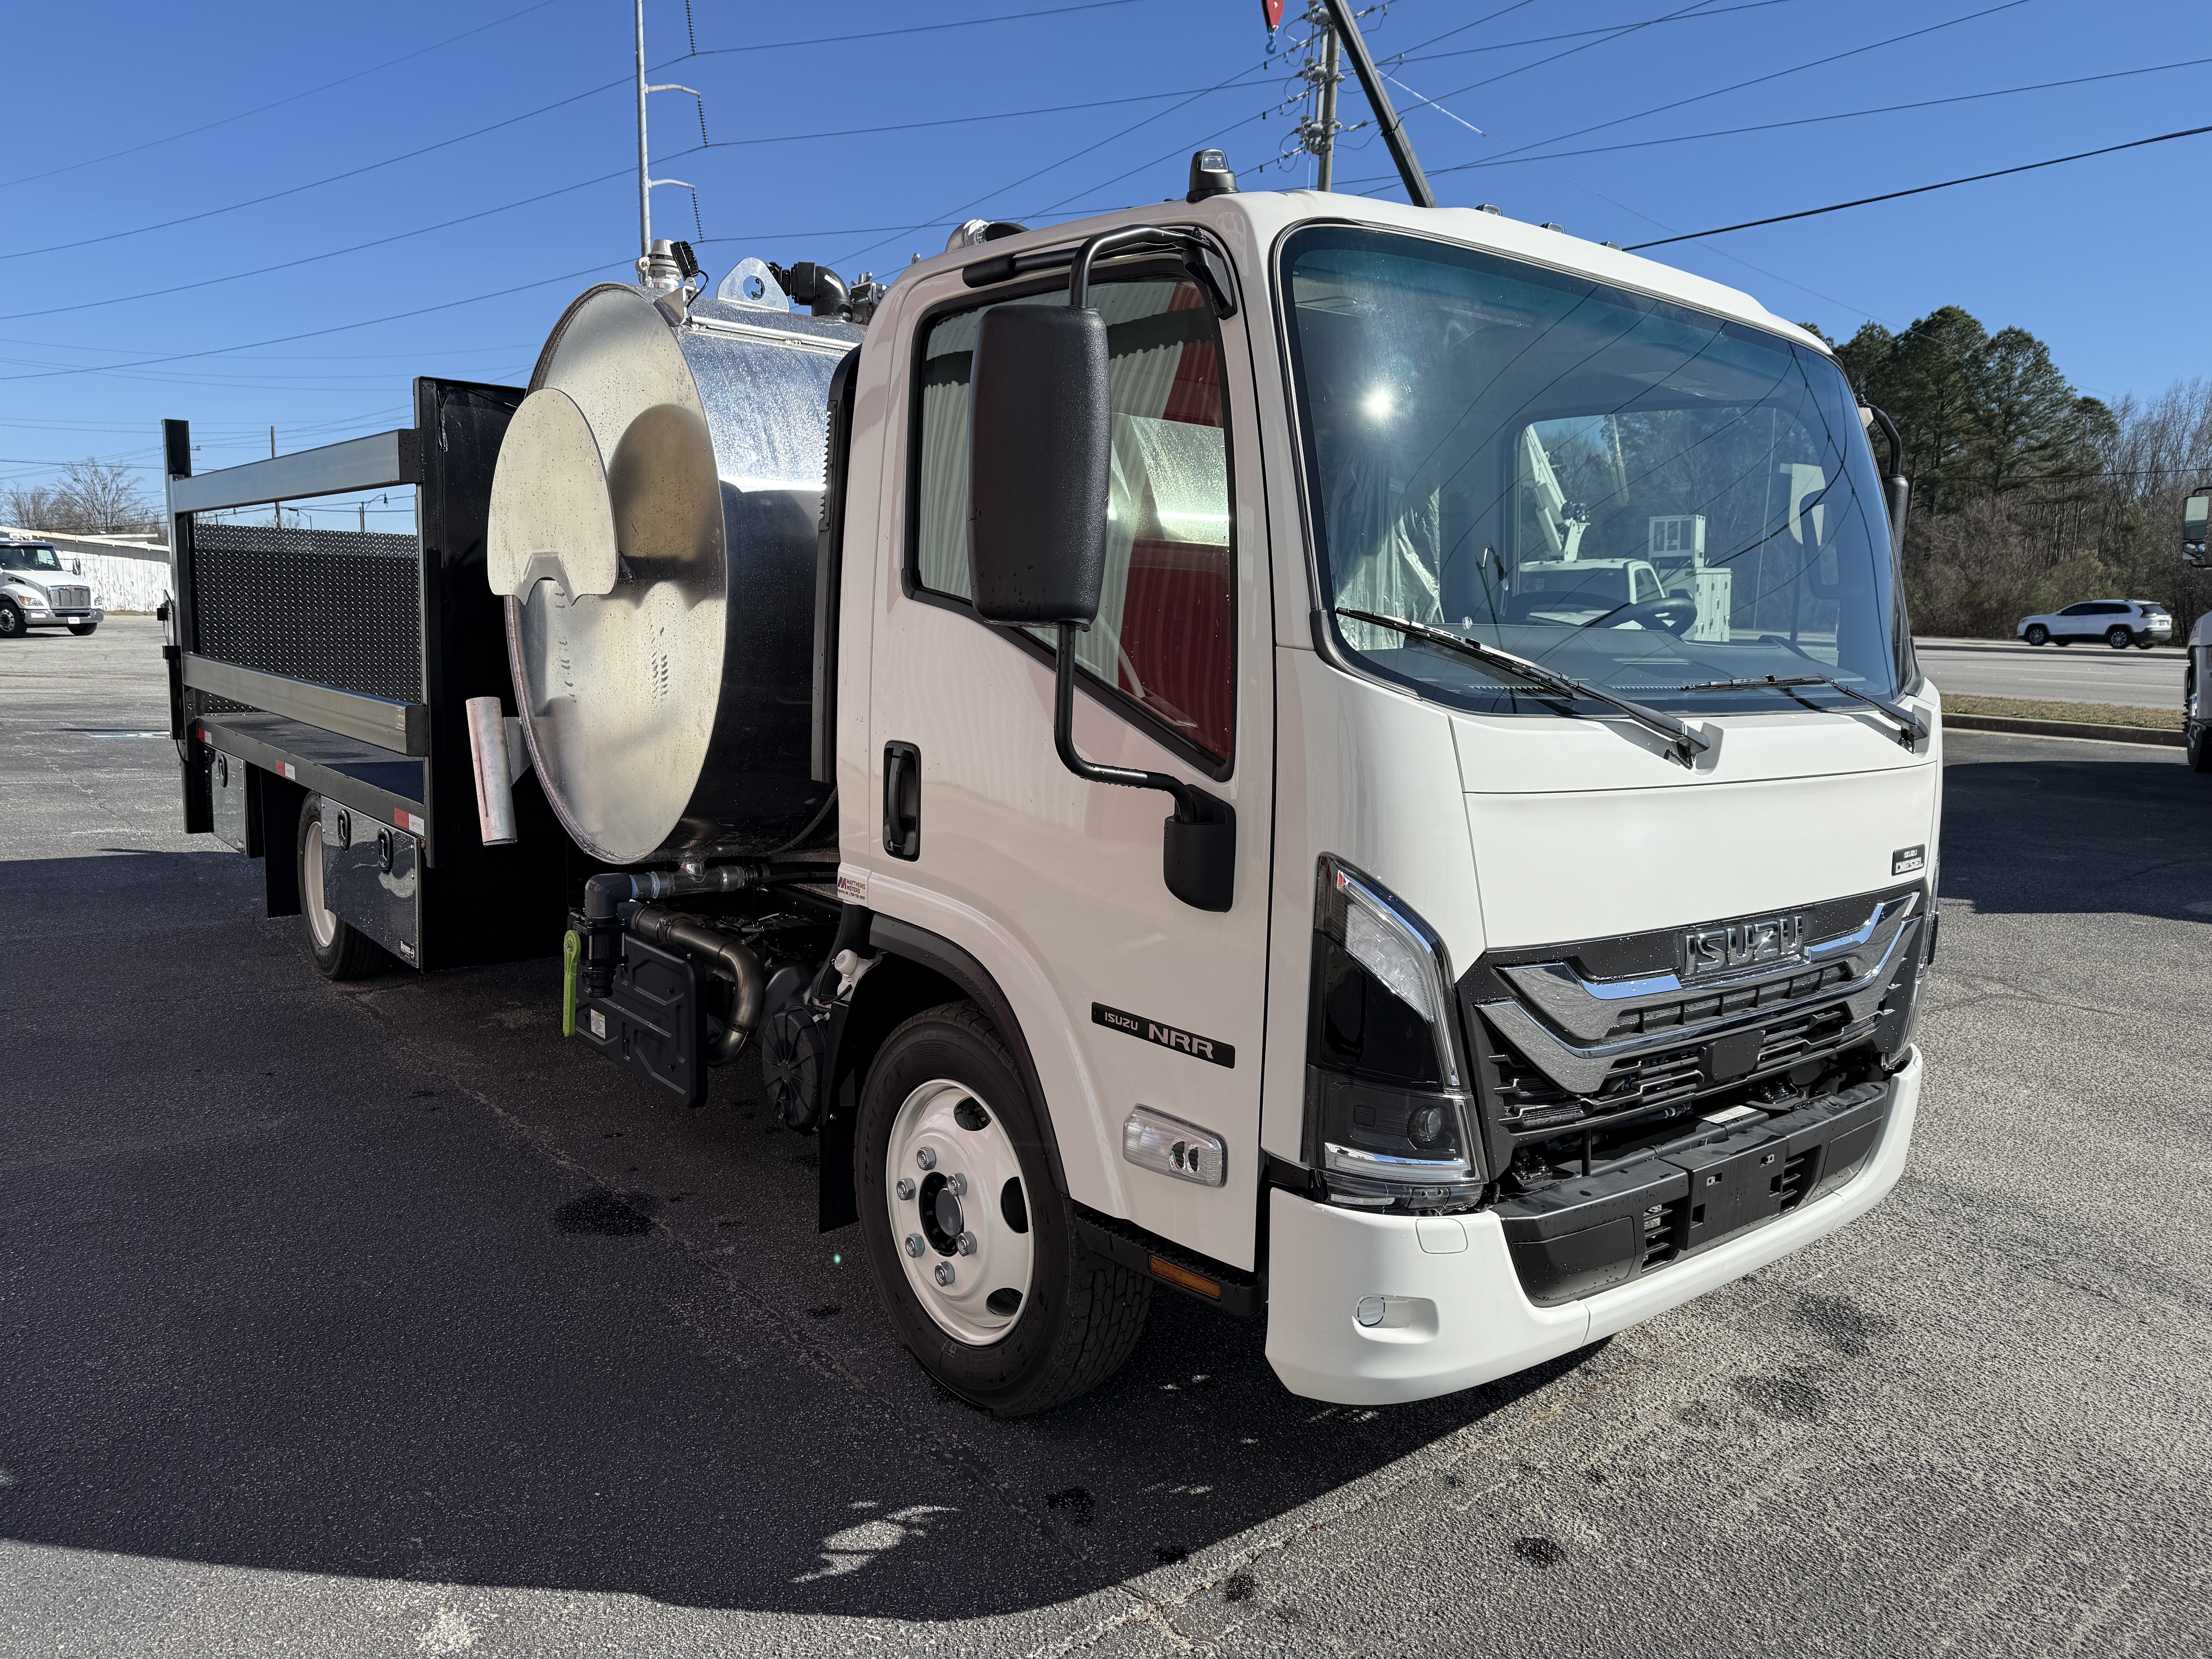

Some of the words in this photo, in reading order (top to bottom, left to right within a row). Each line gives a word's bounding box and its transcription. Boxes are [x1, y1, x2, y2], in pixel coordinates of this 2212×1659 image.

[1904, 849, 1918, 859] ISUZU
[1896, 857, 1923, 873] DIESEL
[847, 879, 866, 889] MATTHEWS
[847, 885, 860, 893] MOTORS
[1685, 915, 1803, 976] ISUZU
[1104, 1012, 1138, 1031] ISUZU
[1148, 1023, 1214, 1060] NRR
